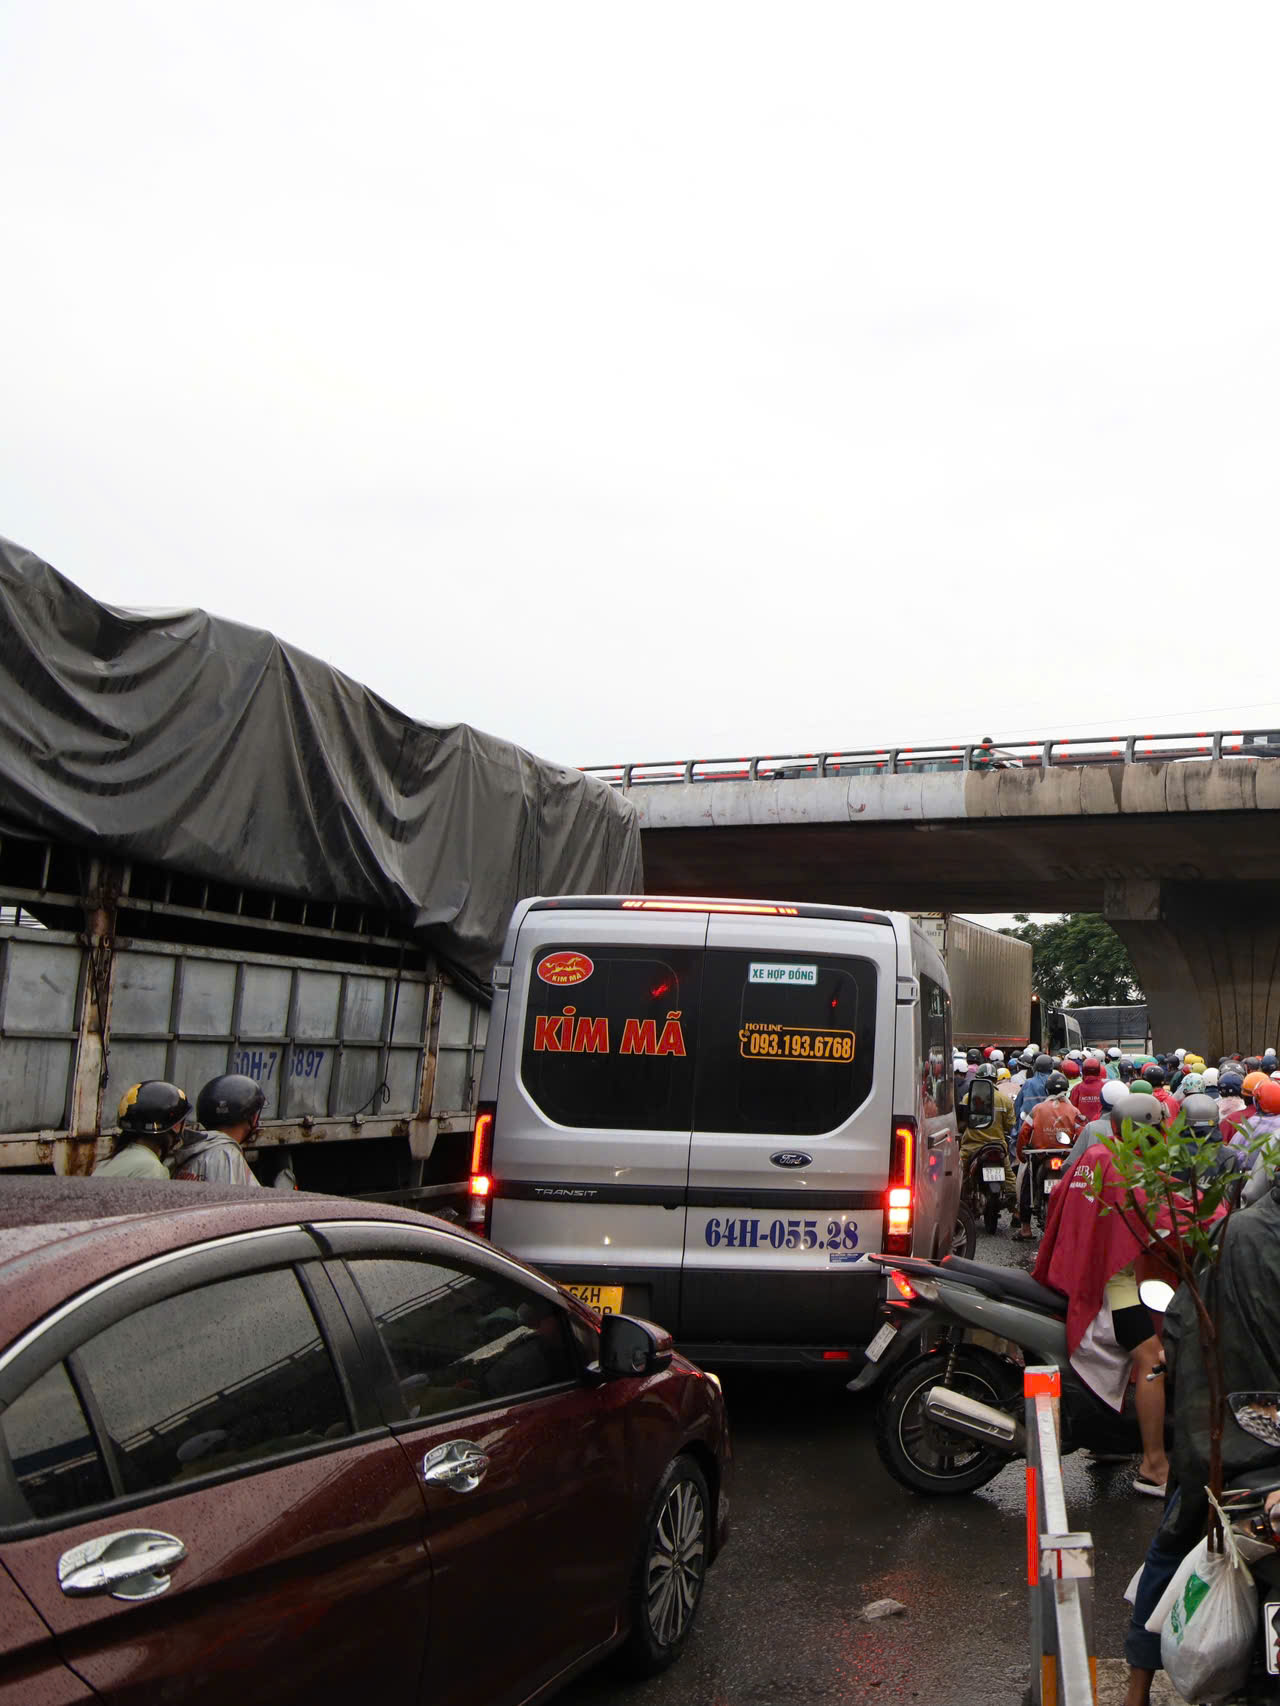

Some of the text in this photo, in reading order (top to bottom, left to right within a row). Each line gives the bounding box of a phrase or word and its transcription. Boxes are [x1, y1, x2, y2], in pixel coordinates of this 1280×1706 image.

[752, 969, 765, 979] XE
[767, 969, 786, 981] HỢP
[619, 1010, 687, 1057] MÃ
[745, 1023, 783, 1032] HOTLINE
[750, 1033, 852, 1058] 093.193.6768
[534, 1188, 598, 1197] TRANSIT
[705, 1217, 859, 1250] 64H-055.28
